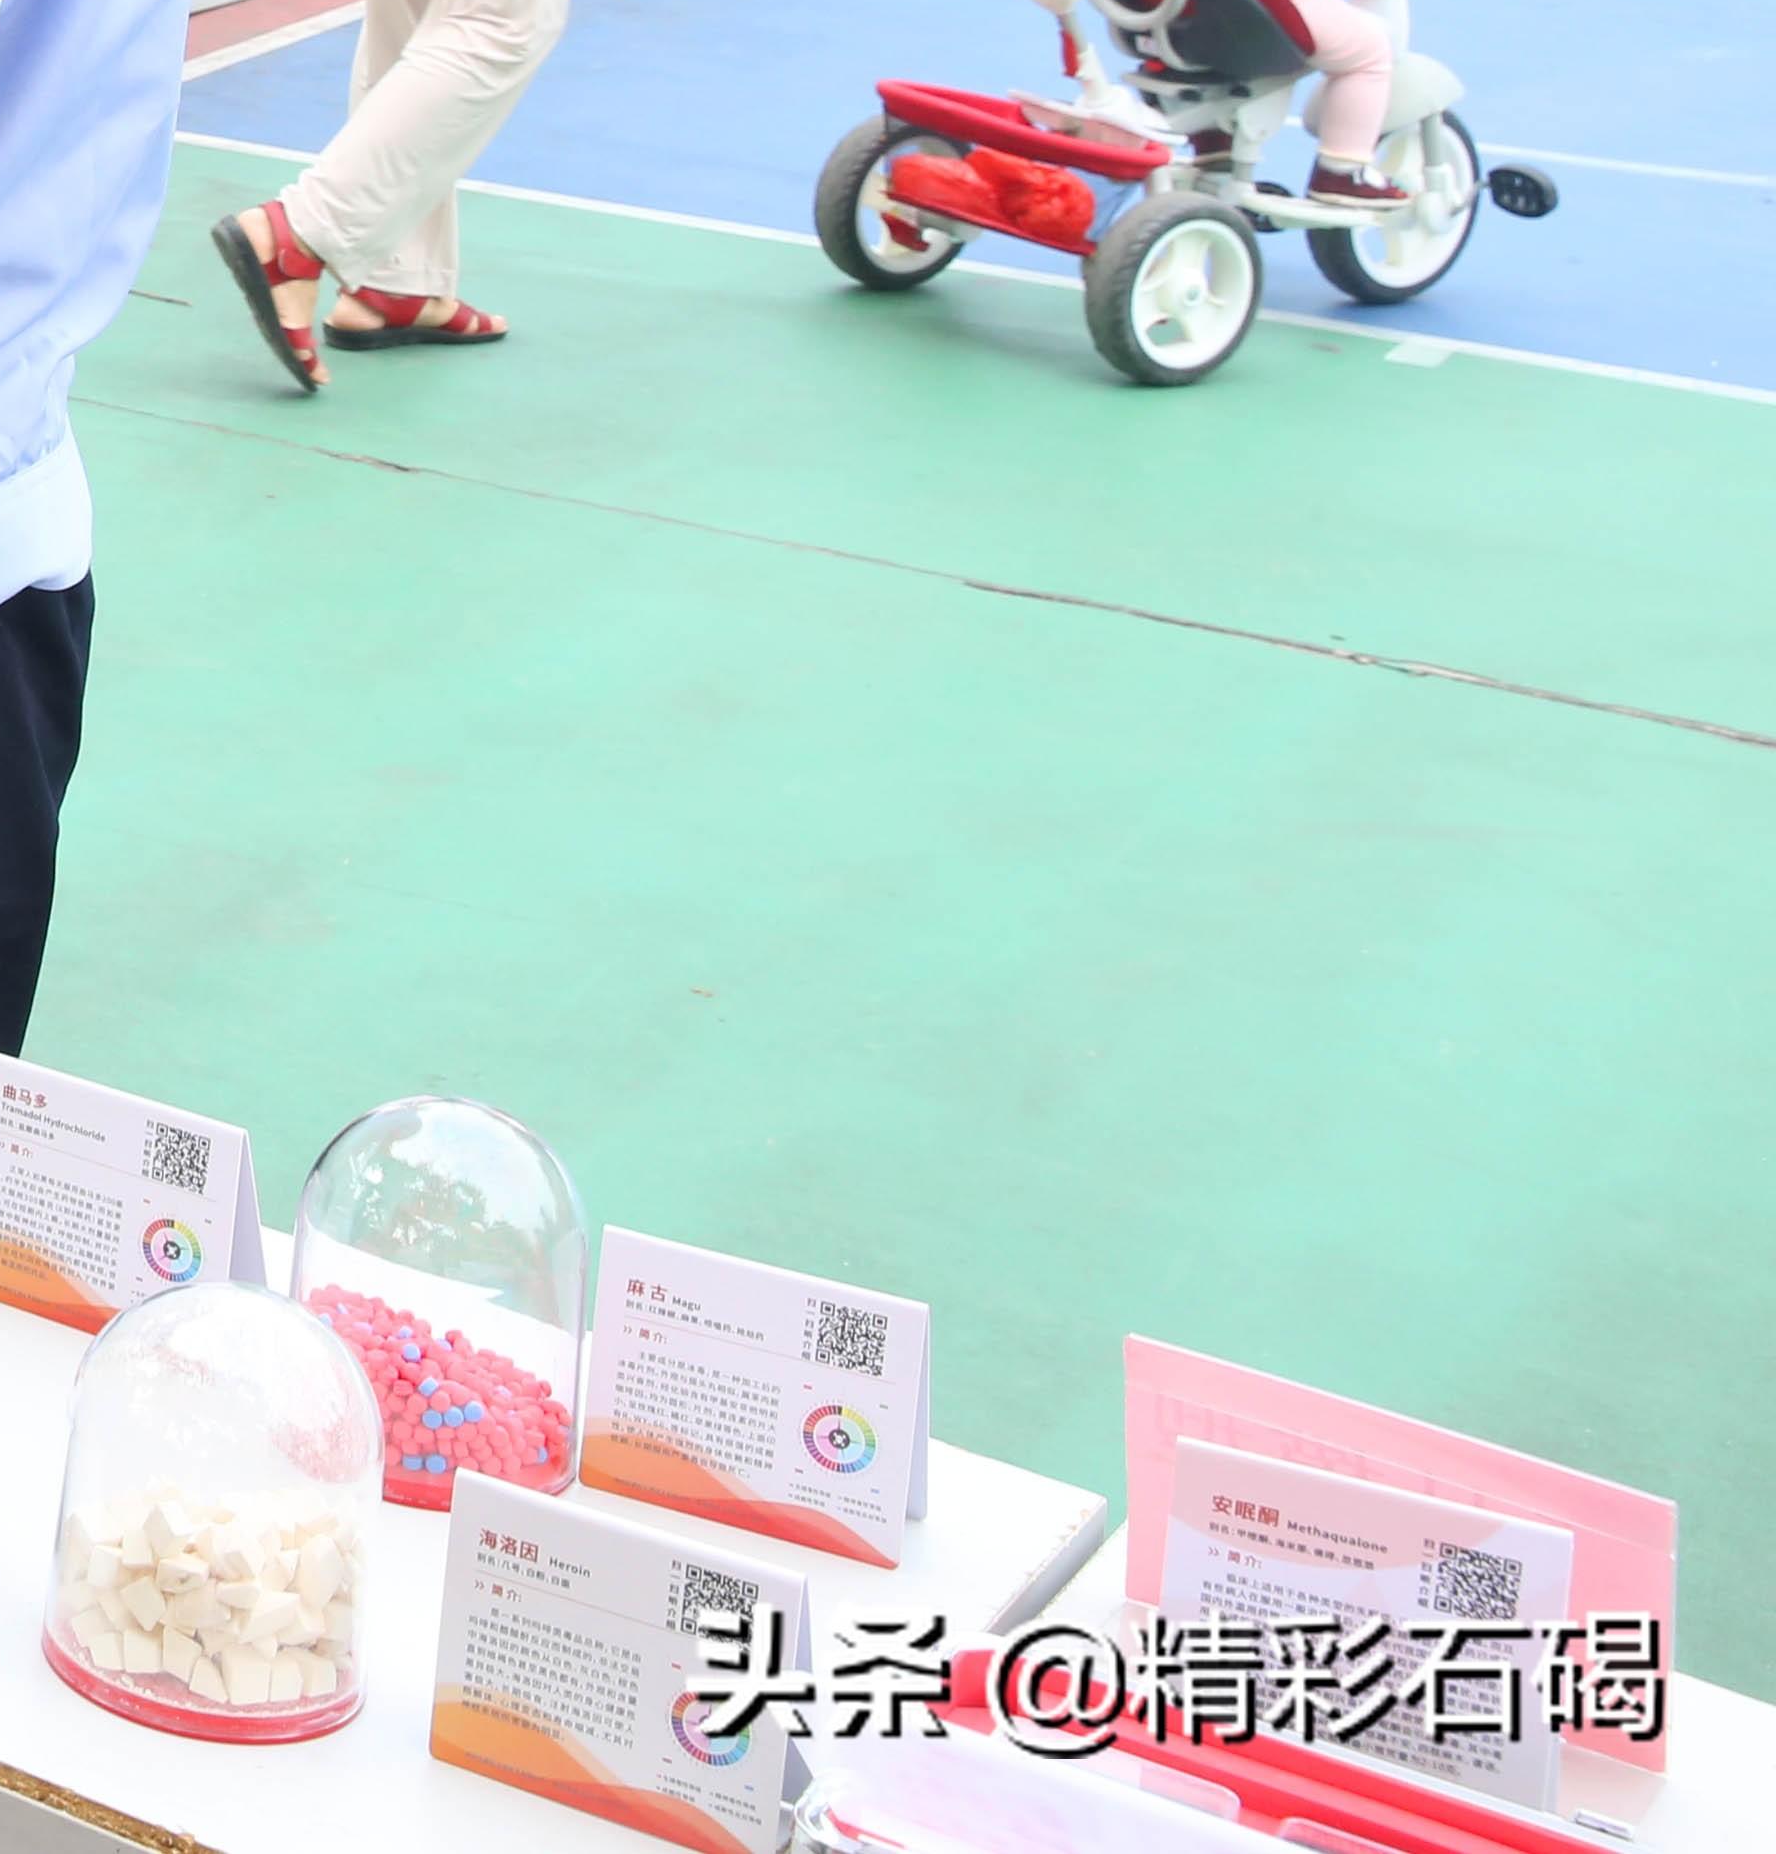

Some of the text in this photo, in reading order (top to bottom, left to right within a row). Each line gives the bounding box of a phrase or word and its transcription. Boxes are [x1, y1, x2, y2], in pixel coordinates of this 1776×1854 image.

[2, 1081, 47, 1111] 曲马多
[0, 1101, 105, 1144] Tramadol Hydrochloride
[626, 1276, 701, 1313] 麻古 Magu
[1211, 1491, 1388, 1557] 安眠酮 Methaqualone
[478, 1526, 591, 1579] 海洛因 Heroin
